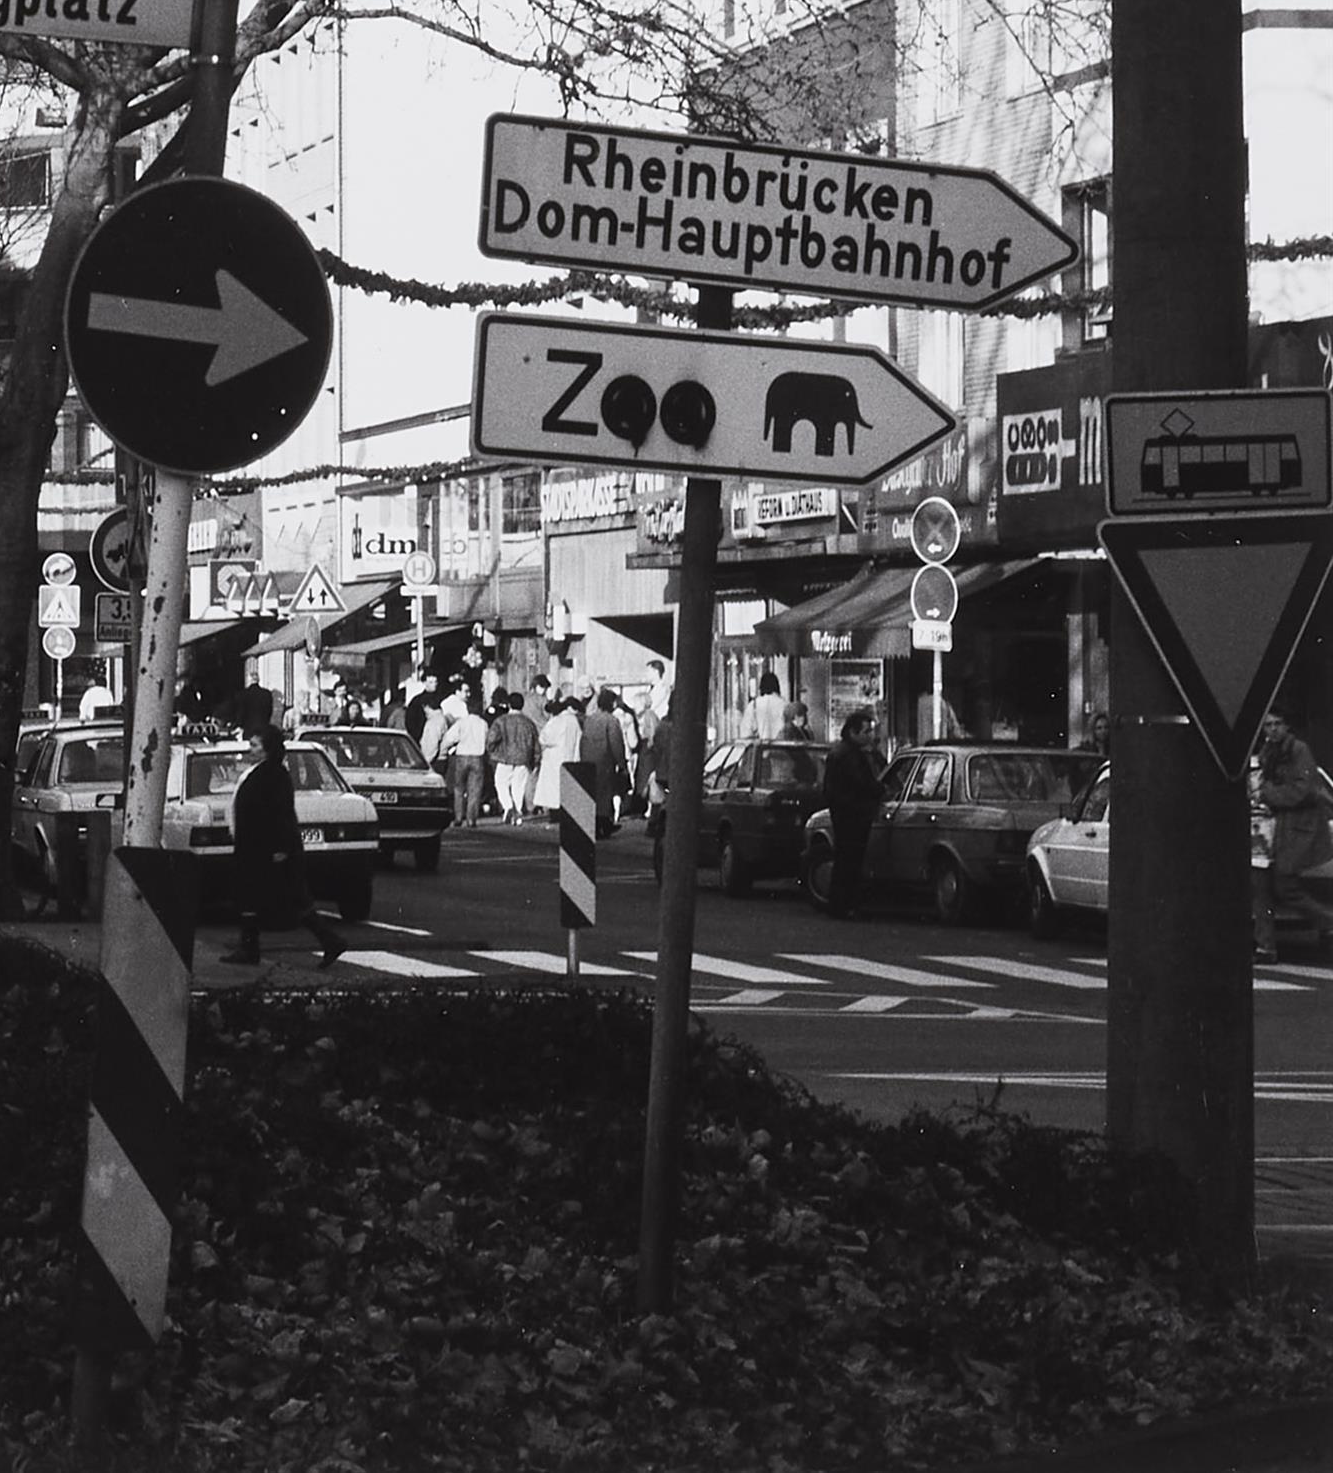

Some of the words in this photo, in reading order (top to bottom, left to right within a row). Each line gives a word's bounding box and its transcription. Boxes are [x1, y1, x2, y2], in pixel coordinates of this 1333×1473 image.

[562, 132, 934, 226] Rheinbrücken
[494, 179, 1013, 290] Dom-Hauptbahnhof
[541, 348, 717, 449] Zoo
[365, 532, 417, 555] dm
[412, 559, 427, 578] H
